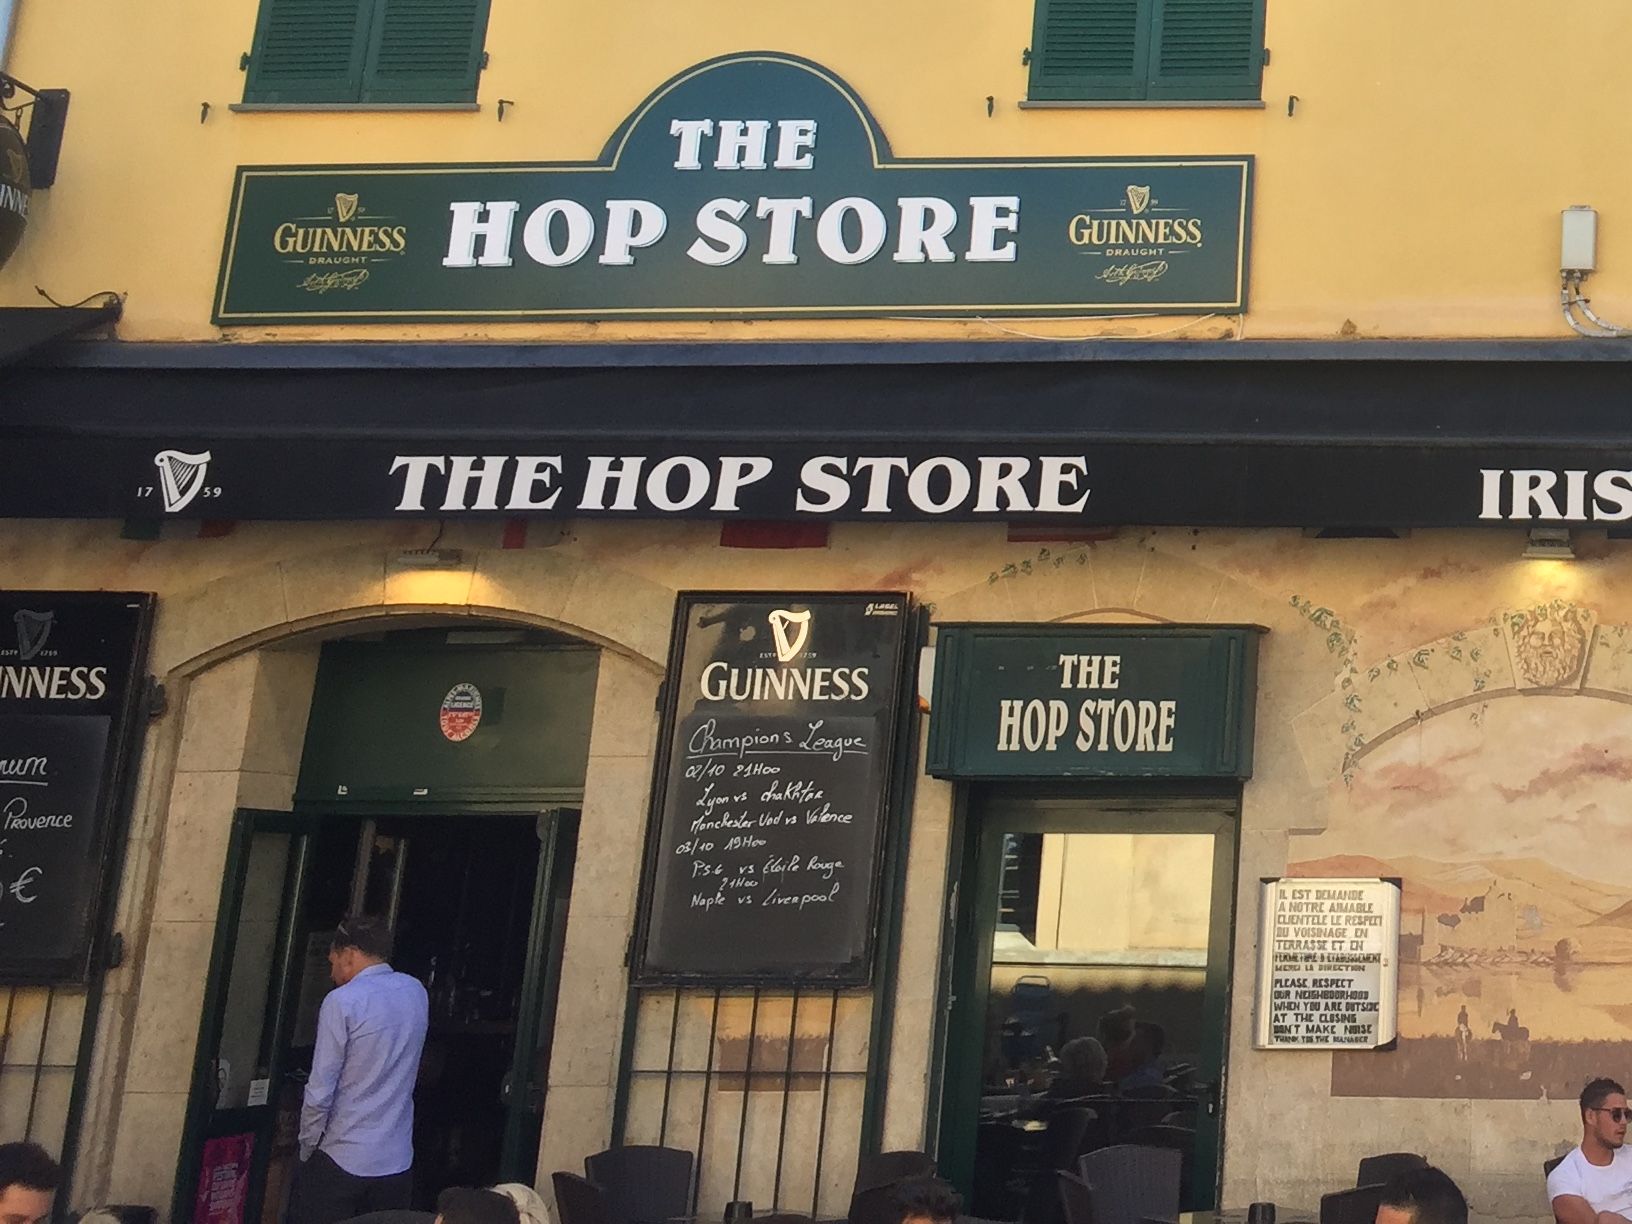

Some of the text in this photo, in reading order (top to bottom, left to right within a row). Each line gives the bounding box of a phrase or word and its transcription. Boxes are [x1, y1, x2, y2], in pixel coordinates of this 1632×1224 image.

[670, 118, 818, 171] THE
[273, 222, 406, 253] GUINNESS
[443, 196, 1020, 268] HOP STORE
[1069, 214, 1202, 246] GUINNESS
[1105, 248, 1165, 257] DRAUGHT
[308, 256, 368, 265] DRAUGHT
[136, 487, 222, 497] 17 59
[389, 455, 1091, 514] THE HOP STORE
[1058, 653, 1121, 689] THE
[700, 661, 869, 701] GUINNESS
[997, 698, 1176, 752] HOP STORE
[799, 720, 867, 761] League
[685, 758, 725, 782] 02/10
[696, 783, 729, 815] Lyon
[733, 792, 748, 803] vs
[785, 813, 797, 825] vs
[806, 803, 853, 825] Valence
[675, 838, 714, 856] 03/10
[739, 864, 755, 874] vs
[691, 892, 726, 912] Naple
[738, 895, 752, 904] vs
[1279, 889, 1364, 900] IL EST DEMANDE
[1278, 902, 1373, 913] A NOTRE AIMABLE
[1277, 914, 1382, 926] CLIENTELE LE RESPECT
[1276, 927, 1289, 937] DU
[1355, 928, 1368, 938] EN
[1276, 939, 1363, 951] TERRASSE ET EN
[1312, 978, 1354, 988] RESPECT
[1274, 990, 1291, 1000] OUR
[1274, 1002, 1379, 1012] WHEN YOU ARE OUTSIDE
[1273, 1013, 1356, 1023] AT THE CLOSING
[1306, 1024, 1336, 1034] MAKE
[1344, 1024, 1372, 1034] NOISE
